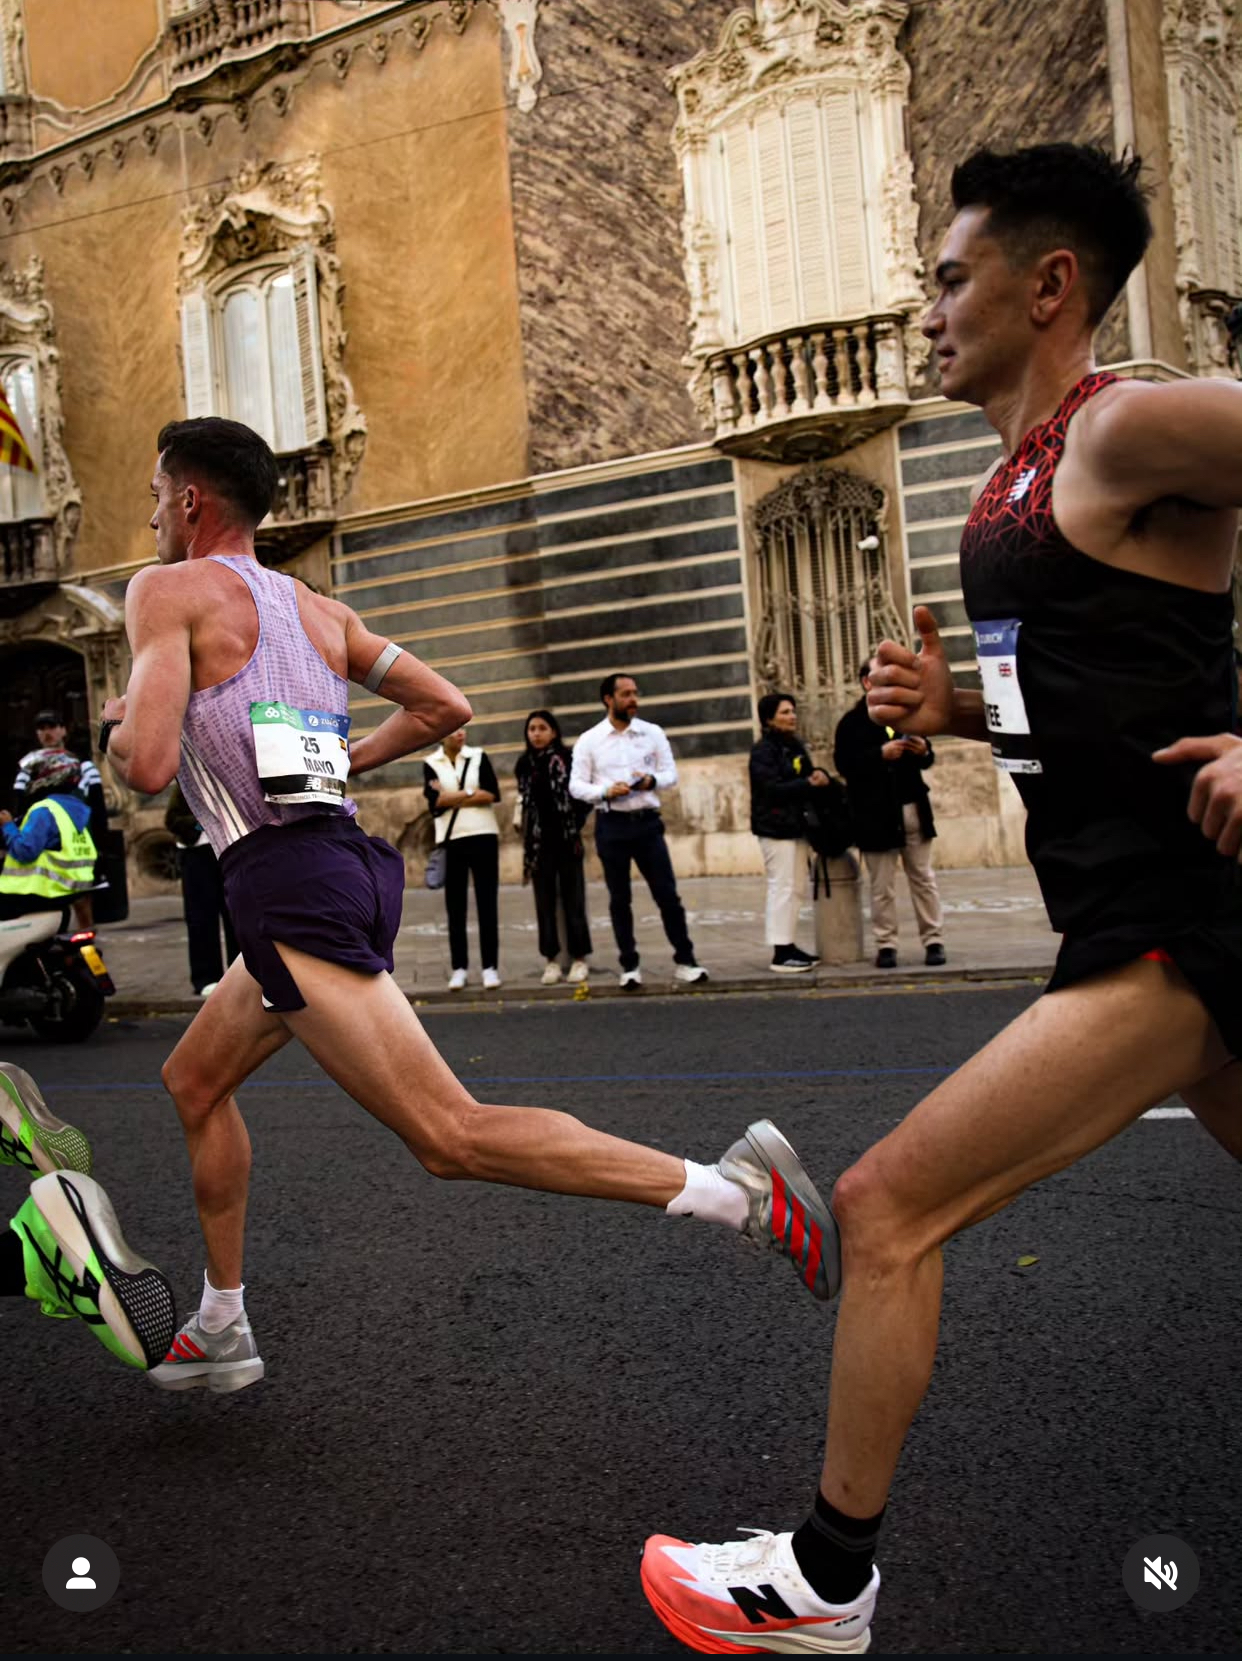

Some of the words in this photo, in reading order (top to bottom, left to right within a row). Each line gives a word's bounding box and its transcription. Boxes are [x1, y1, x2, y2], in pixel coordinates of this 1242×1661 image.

[984, 704, 1002, 727] EE
[300, 735, 321, 755] 25
[303, 757, 335, 775] MAYO
[727, 1583, 799, 1625] N
